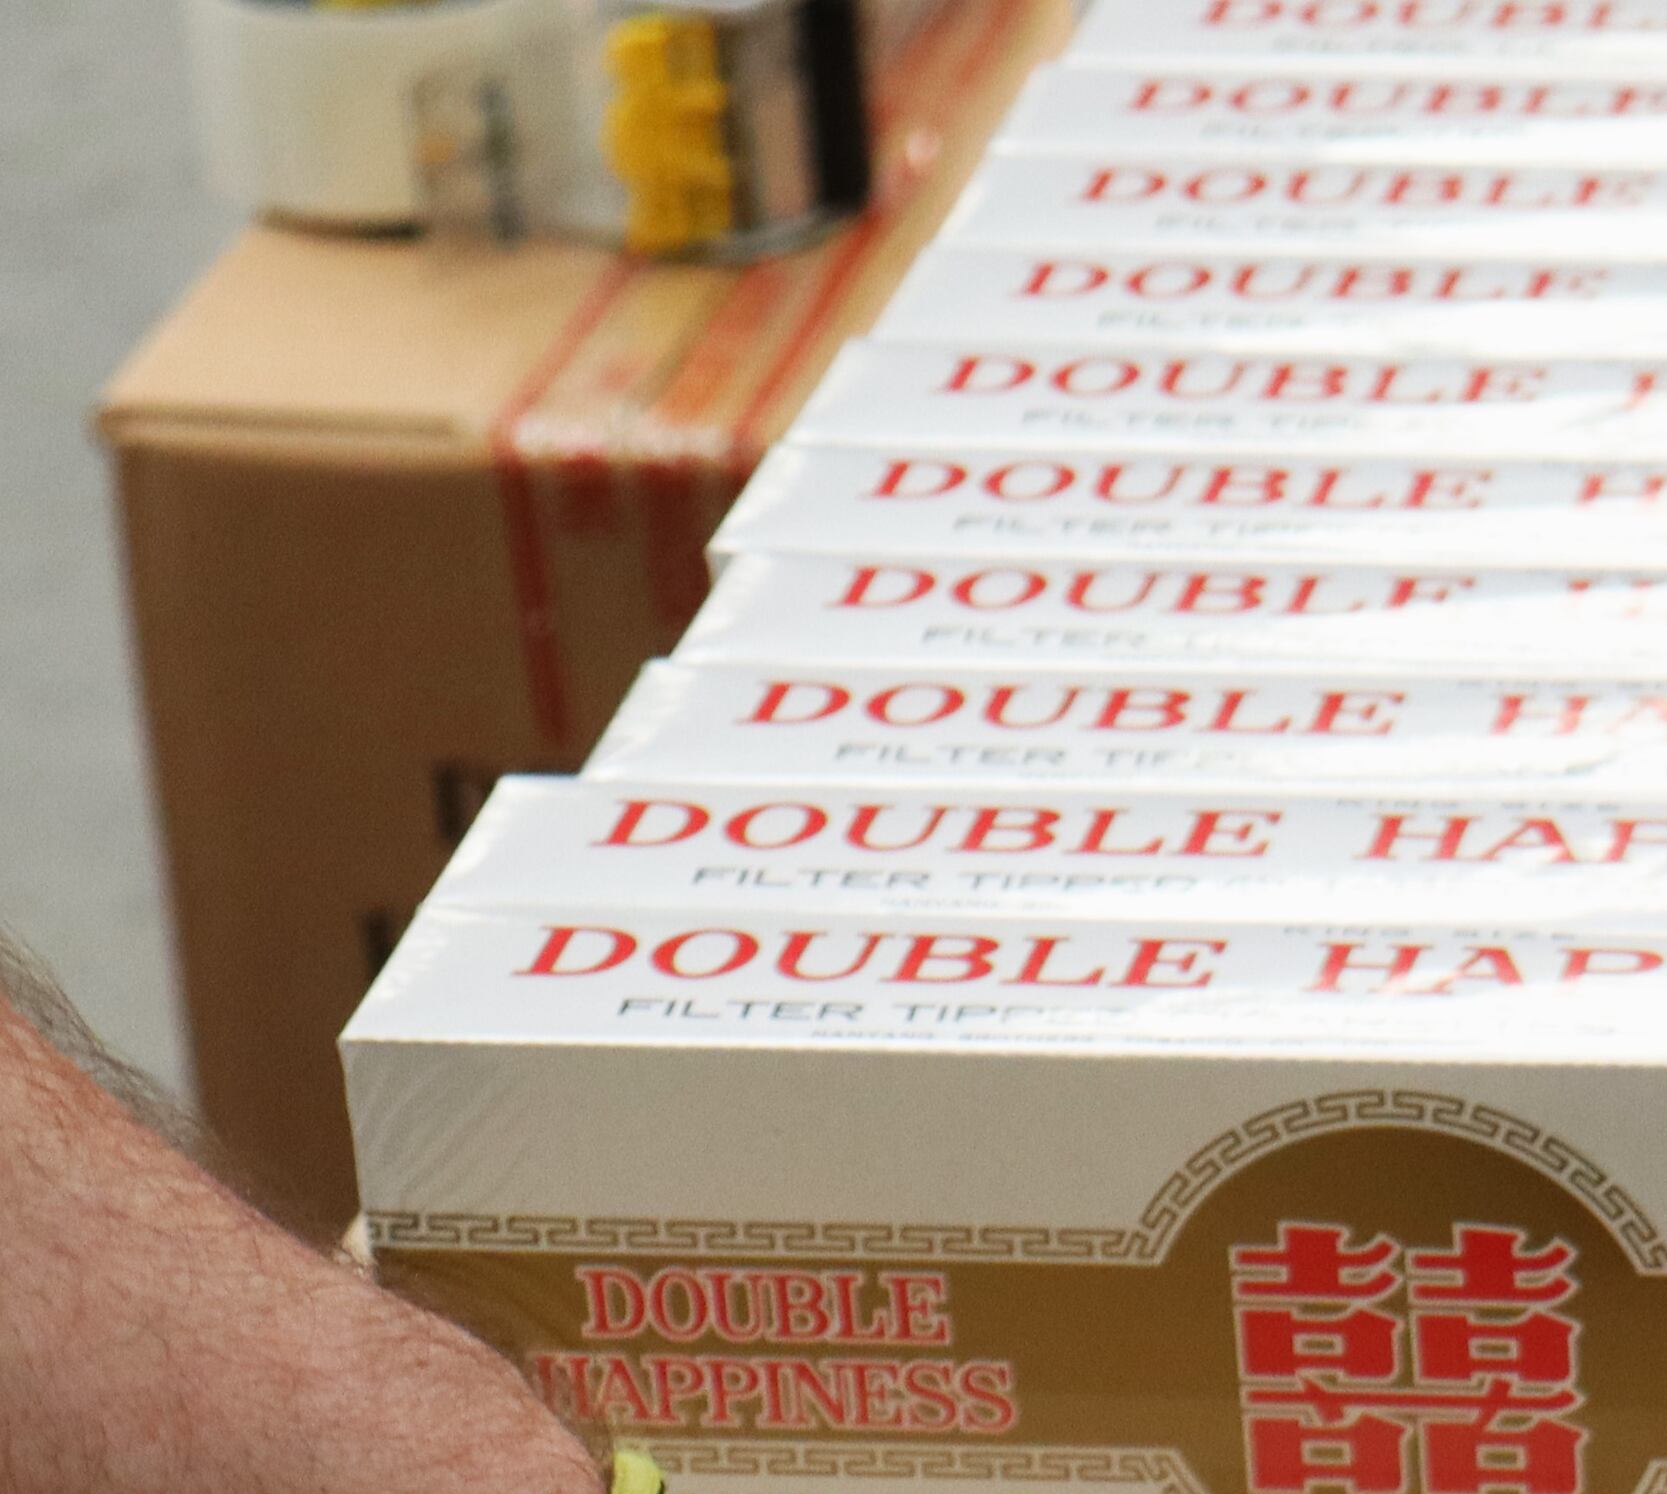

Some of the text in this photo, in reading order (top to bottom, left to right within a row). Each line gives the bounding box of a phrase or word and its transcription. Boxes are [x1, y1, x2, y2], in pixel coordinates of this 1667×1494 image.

[1078, 163, 1654, 209] DOUBLE
[1014, 256, 1609, 303] DOUBLE
[940, 352, 1547, 405] DOUBLE
[868, 456, 1495, 511] DOUBLE
[831, 562, 1477, 616] DOUBLE
[739, 677, 1407, 736] DOUBLE
[834, 742, 1066, 766] FILTER
[592, 795, 1284, 859] DOUBLE
[692, 866, 930, 889] FILTER
[512, 922, 1230, 989] DOUBLE
[617, 997, 864, 1021] FILTER
[575, 1263, 951, 1346] DOUBLE
[527, 1350, 1018, 1434] HAPPINESS
